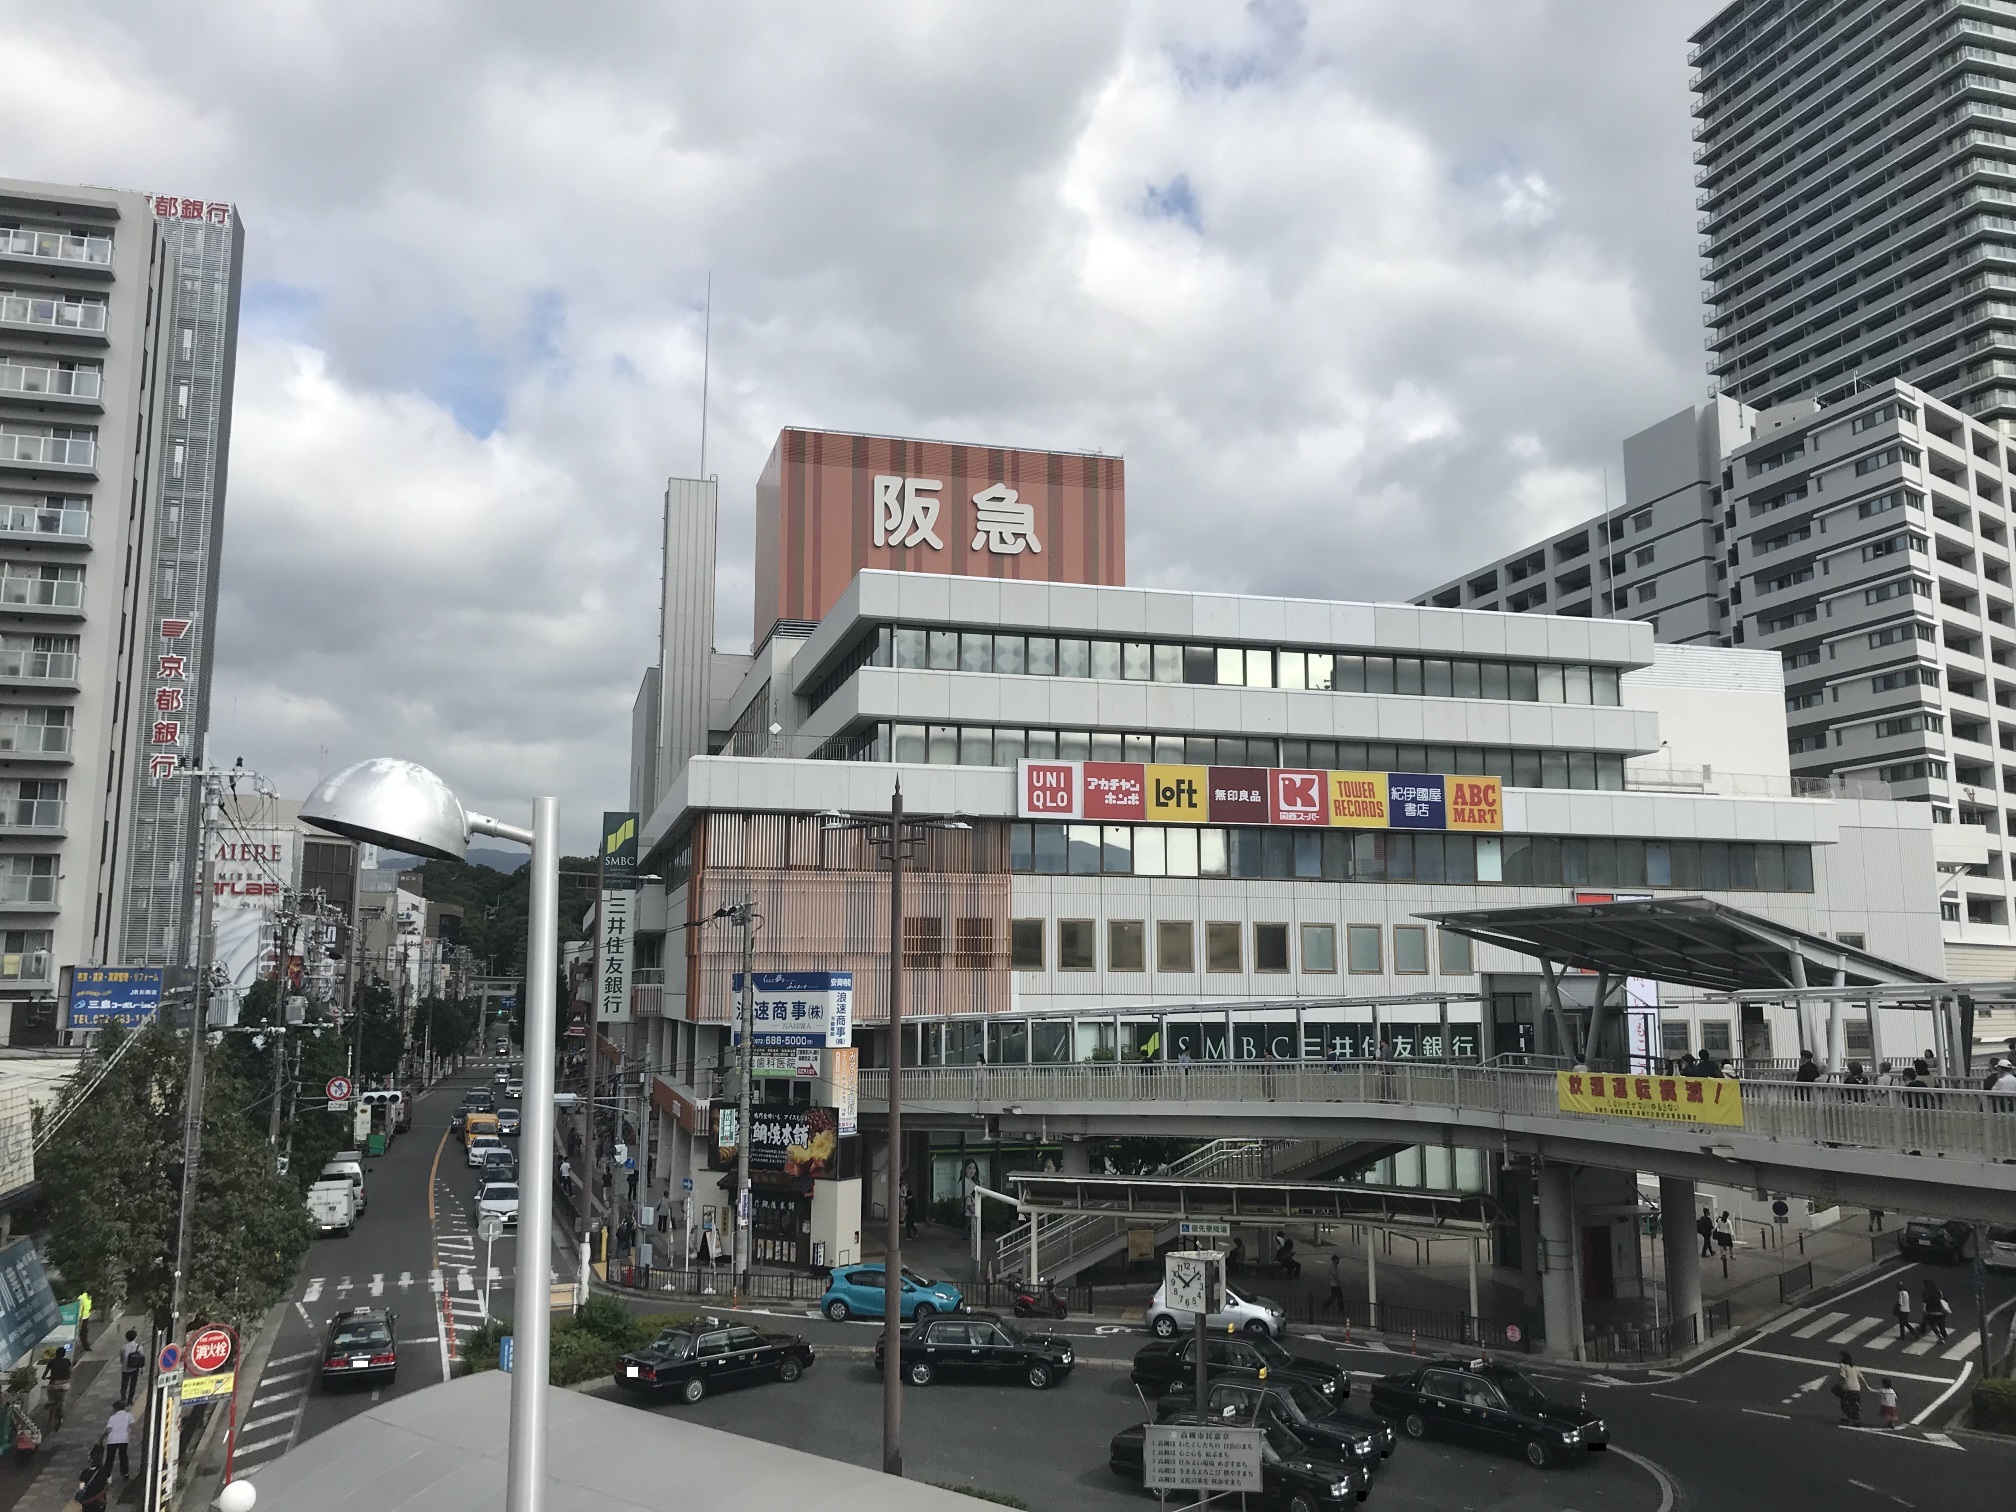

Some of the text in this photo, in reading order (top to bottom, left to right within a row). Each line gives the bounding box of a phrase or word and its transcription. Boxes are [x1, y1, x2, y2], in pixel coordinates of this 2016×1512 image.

[145, 195, 229, 224] 都銀行
[874, 475, 1041, 554] 阪急
[150, 655, 184, 779] 京都銀行
[1033, 771, 1064, 787] UNI
[1087, 777, 1140, 791] アカチャン
[1215, 788, 1261, 803] 無印良品
[1337, 781, 1375, 799] TOWER
[1391, 787, 1442, 802] 紀伊國屋
[1453, 784, 1497, 807] ABC
[1033, 790, 1068, 809] QLO
[1334, 799, 1385, 818] RECORDS
[1280, 812, 1320, 821] 関西スーパー
[1404, 803, 1430, 817] 書店
[1453, 808, 1497, 823] MART
[605, 856, 635, 866] SMBC
[603, 897, 626, 1013] 三井住友銀行
[195, 1341, 227, 1360] 消火栓
